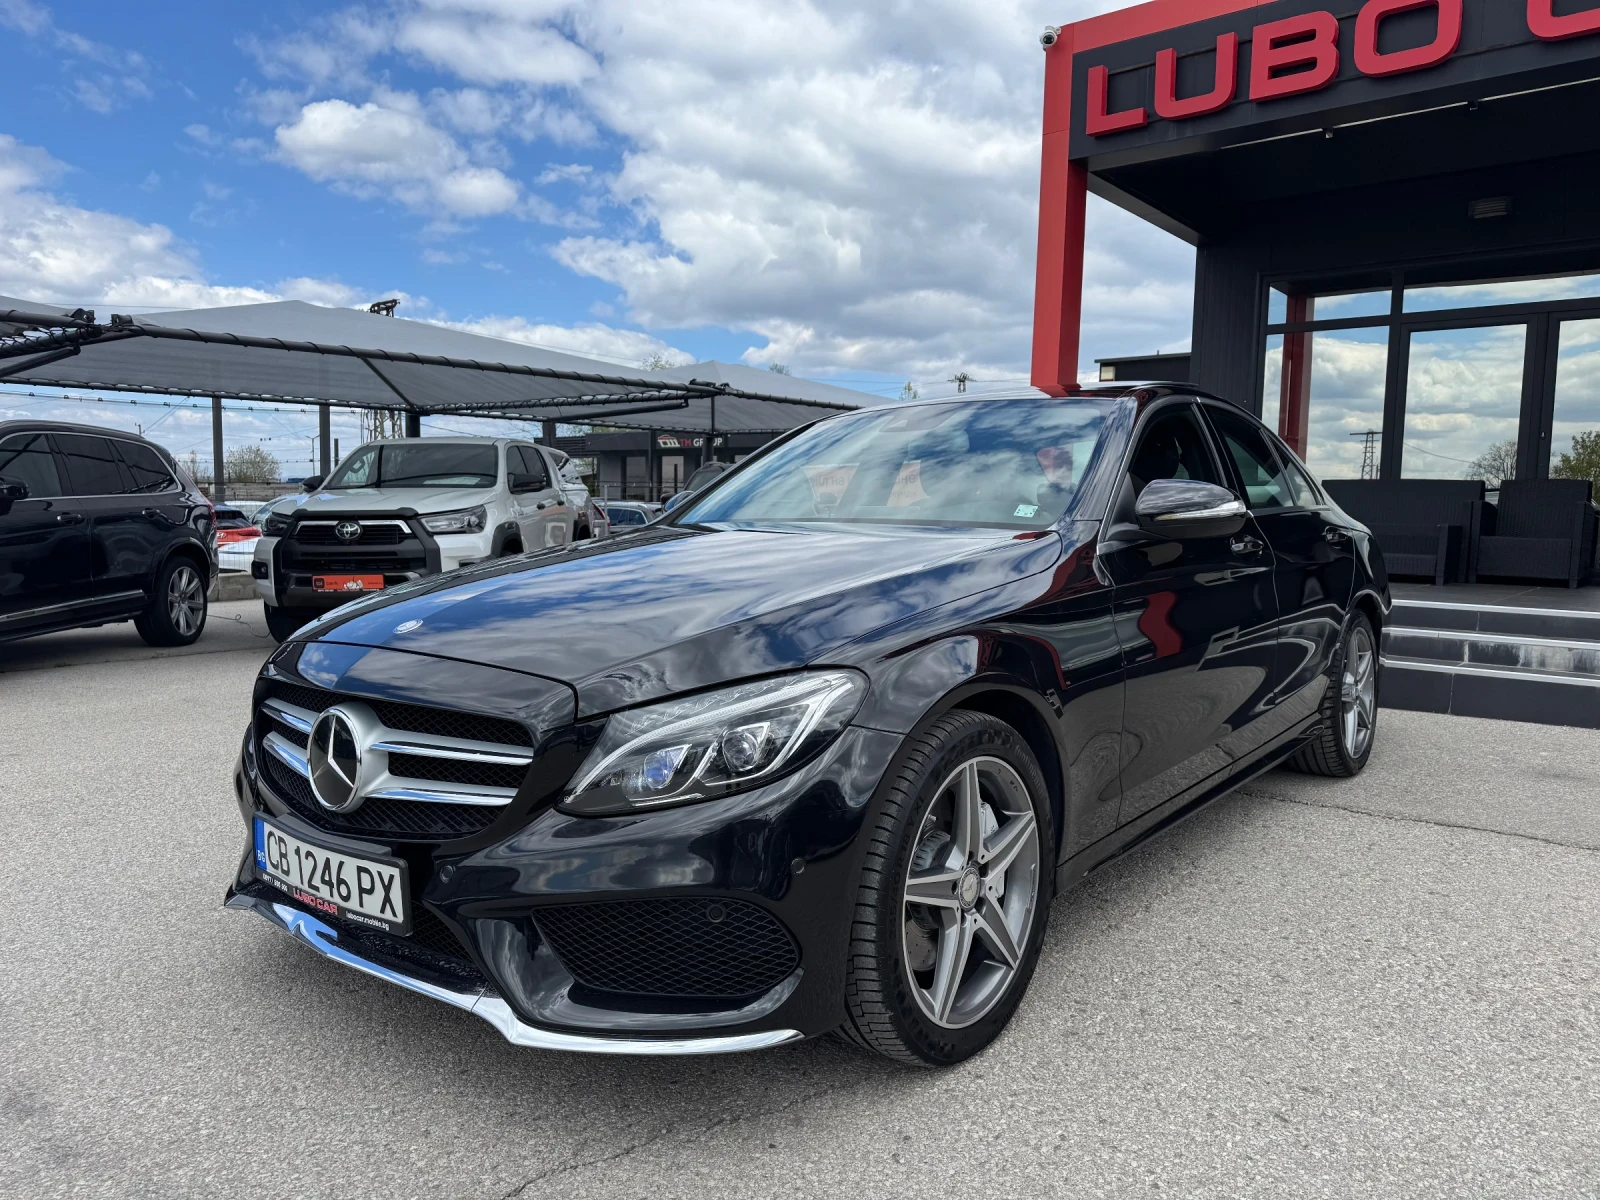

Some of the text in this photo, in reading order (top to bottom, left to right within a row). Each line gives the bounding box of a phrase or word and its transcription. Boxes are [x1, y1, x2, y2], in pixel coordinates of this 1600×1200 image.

[1086, 0, 1463, 137] LUBO
[693, 437, 723, 447] GRUP
[257, 849, 266, 863] BG
[266, 830, 398, 919] CB 1246 PX
[293, 887, 338, 916] LUBO CAR
